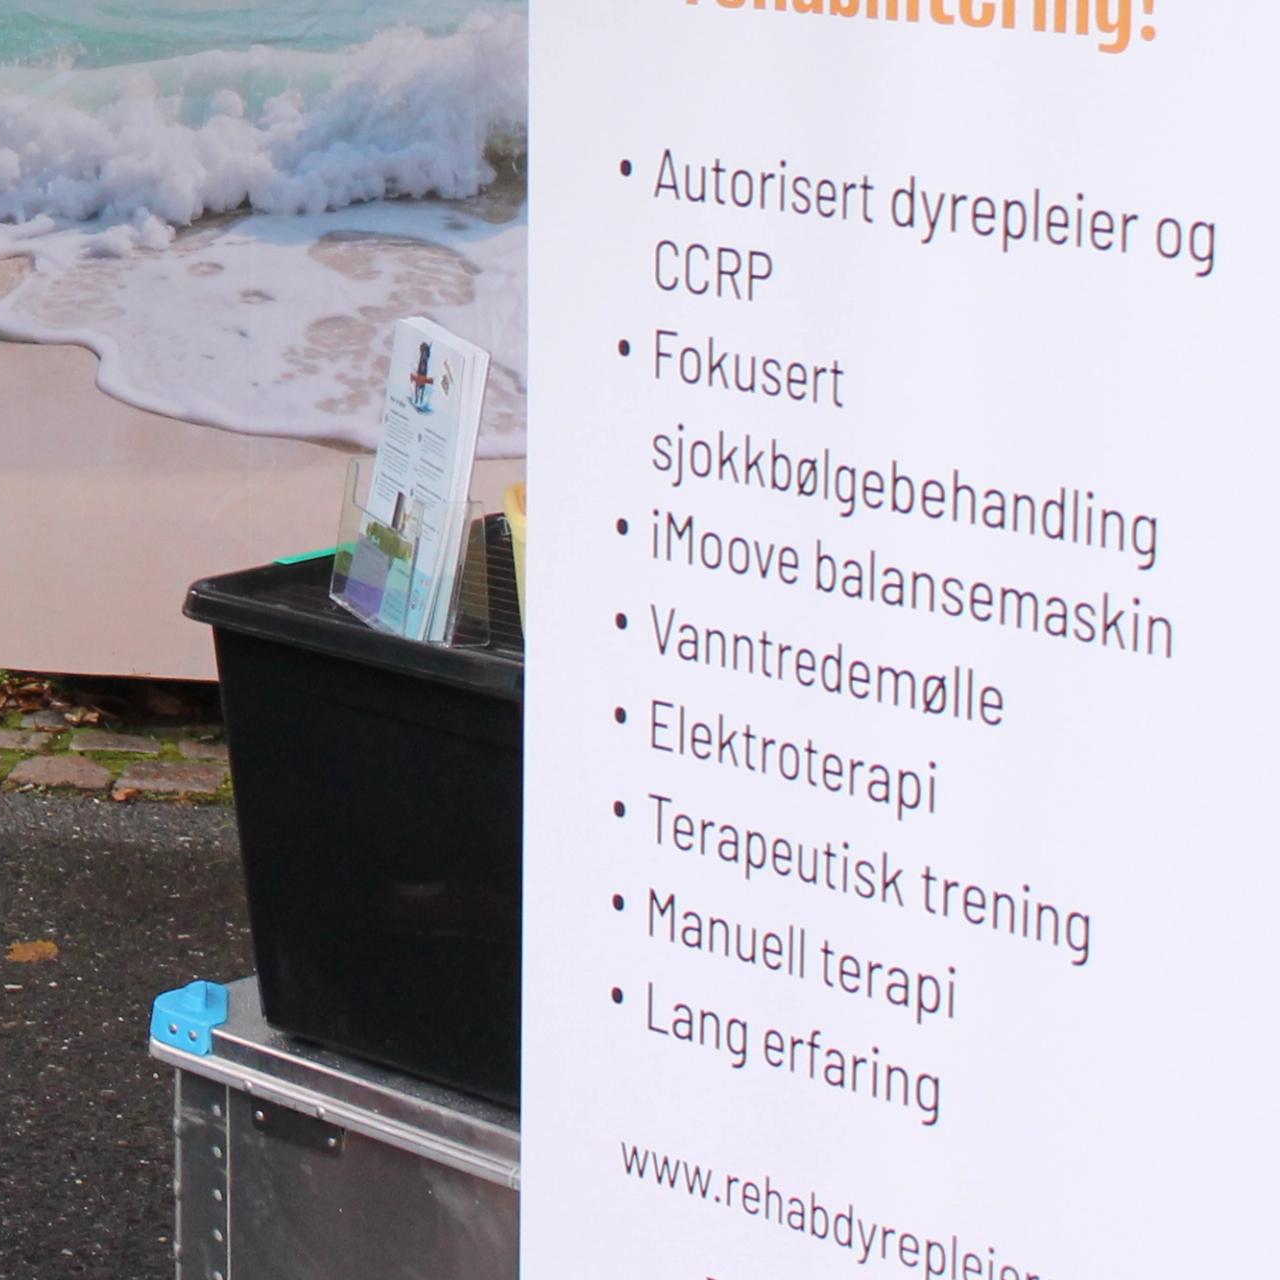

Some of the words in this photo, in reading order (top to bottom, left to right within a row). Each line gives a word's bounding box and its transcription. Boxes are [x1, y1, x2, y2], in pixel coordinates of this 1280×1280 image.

[654, 148, 874, 225] Autorisert
[890, 174, 1139, 253] dyrepleier
[1155, 216, 1217, 277] og
[654, 239, 774, 301] CCRP
[654, 329, 845, 408] Fokusert
[652, 423, 1159, 571] sjokkbølgebehandling
[652, 508, 801, 585] iMoove
[815, 539, 1173, 658] balansemaskin
[651, 602, 1005, 727] Vanntredemølle
[651, 700, 938, 820] Elektroterapi
[647, 792, 904, 906] Terapeutisk
[920, 865, 1092, 966] trening
[647, 888, 806, 979] Manuell
[820, 938, 957, 1024] terapi
[646, 982, 748, 1068] Lang
[763, 1030, 942, 1126] erfaring
